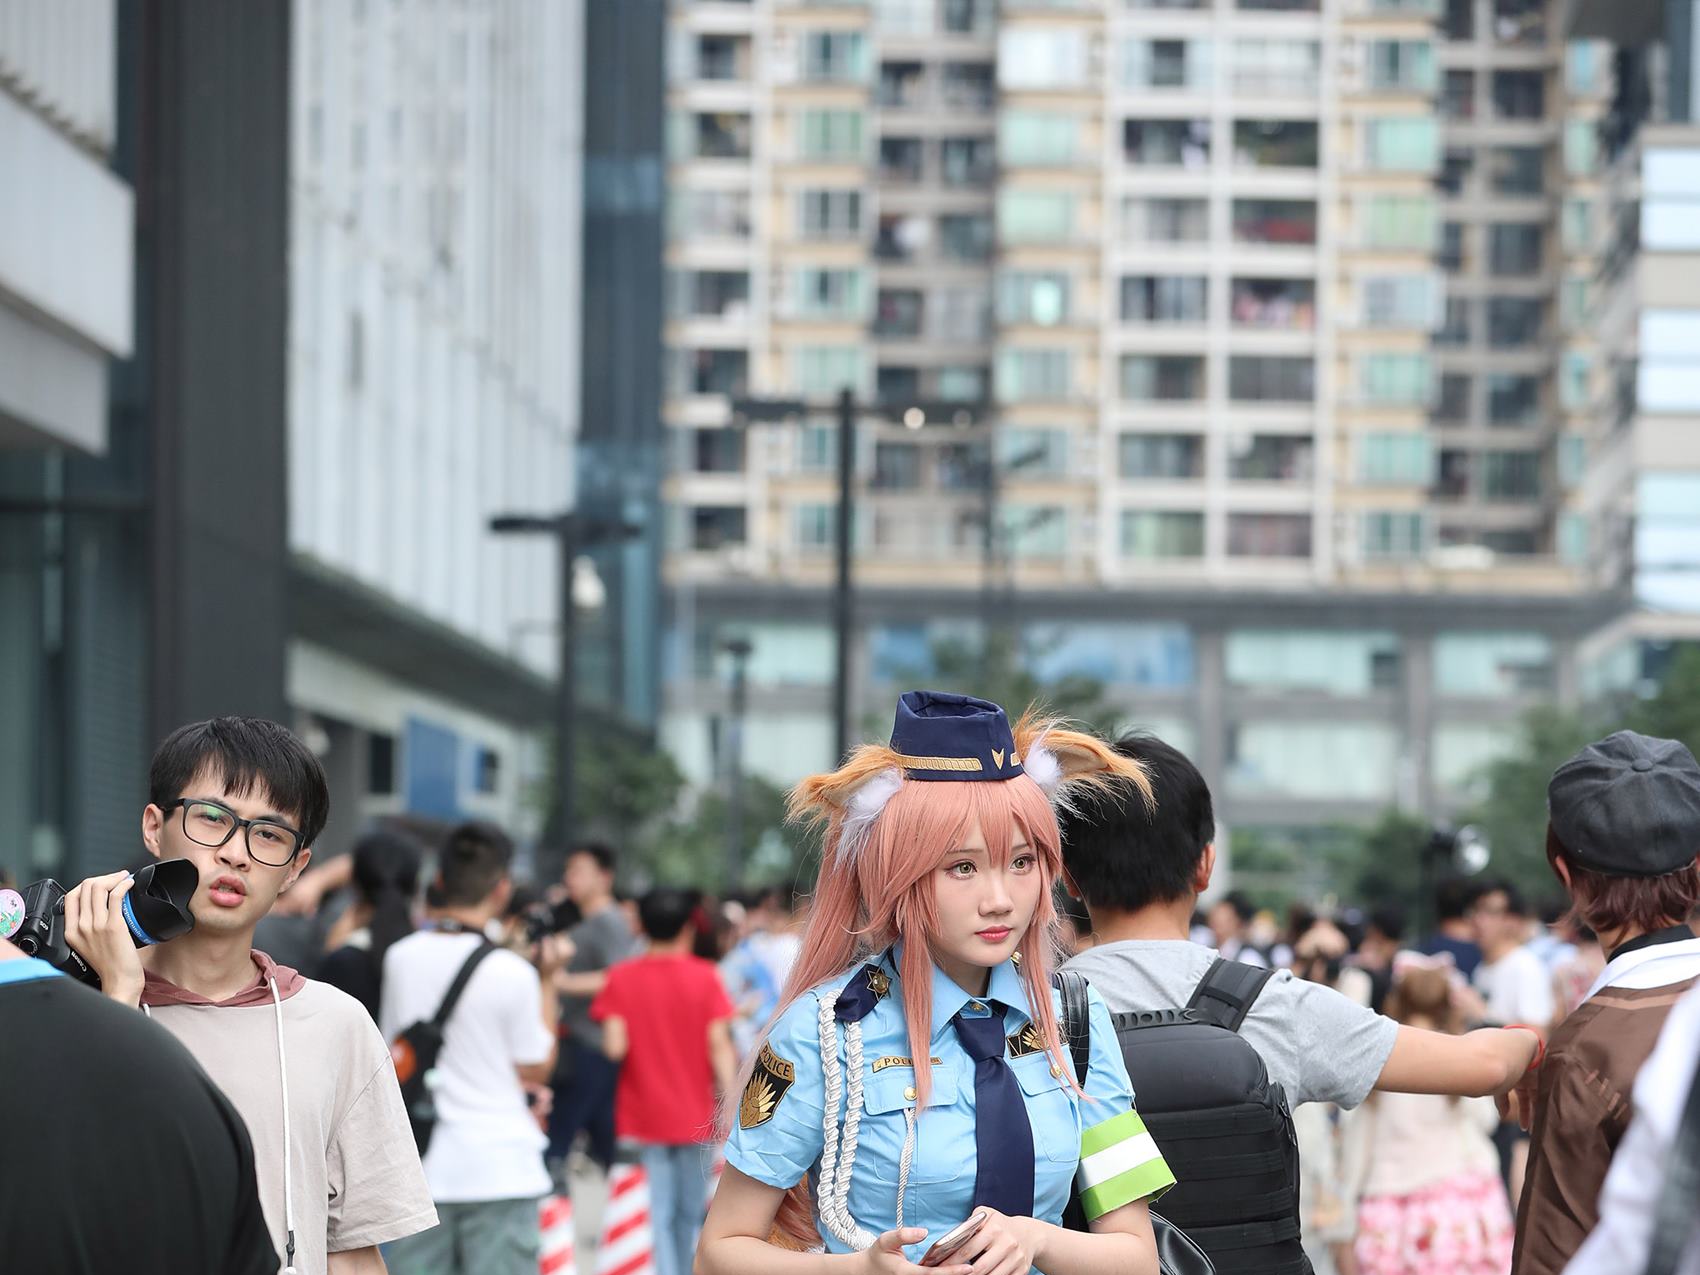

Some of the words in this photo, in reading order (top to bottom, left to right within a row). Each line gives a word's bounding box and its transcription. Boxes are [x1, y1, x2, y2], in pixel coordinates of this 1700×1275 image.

[71, 951, 87, 972] Canon
[762, 1044, 791, 1078] POLICE
[884, 1057, 912, 1066] POLI
